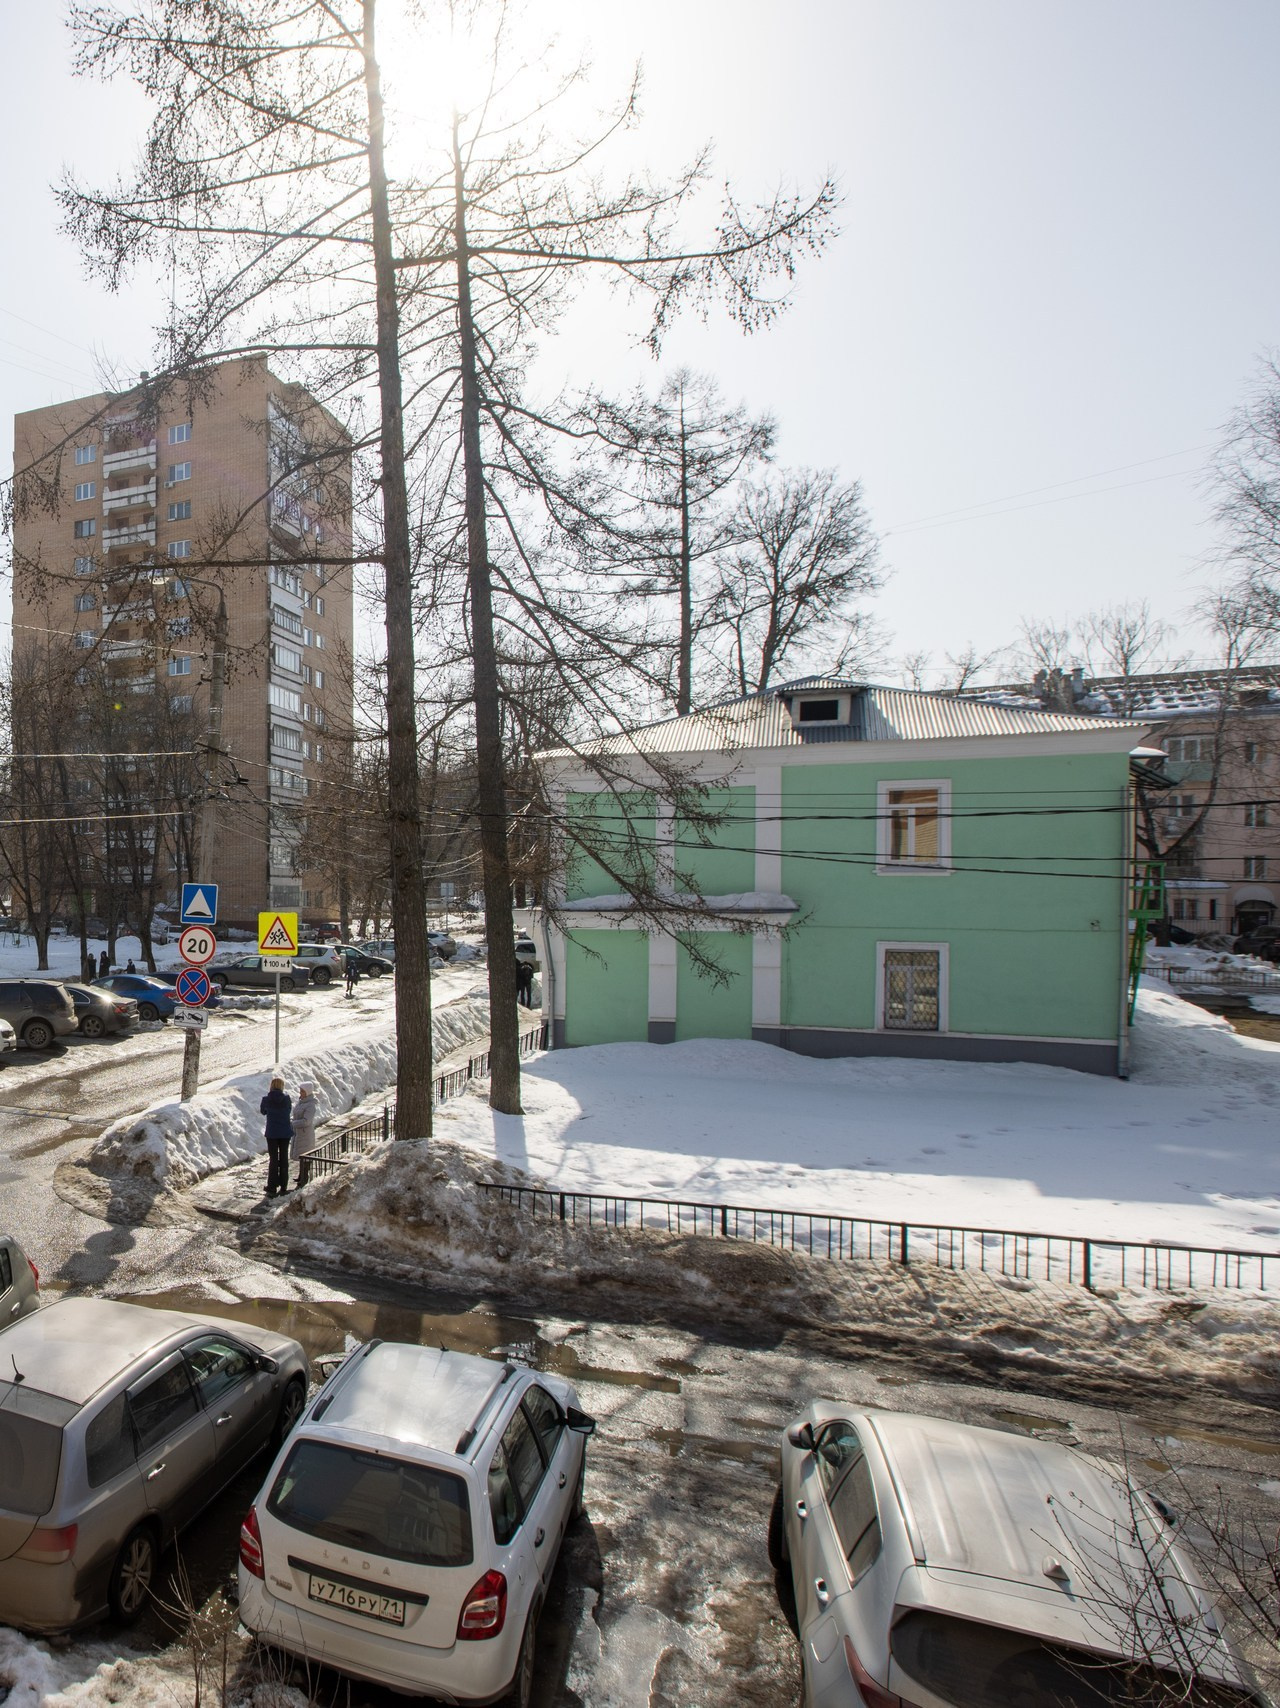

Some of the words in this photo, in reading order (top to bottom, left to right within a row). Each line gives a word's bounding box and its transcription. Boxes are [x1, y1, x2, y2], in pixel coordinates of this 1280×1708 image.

[187, 938, 208, 954] 20
[269, 960, 279, 968] 100
[322, 1549, 391, 1576] LADA
[382, 1598, 397, 1614] 71
